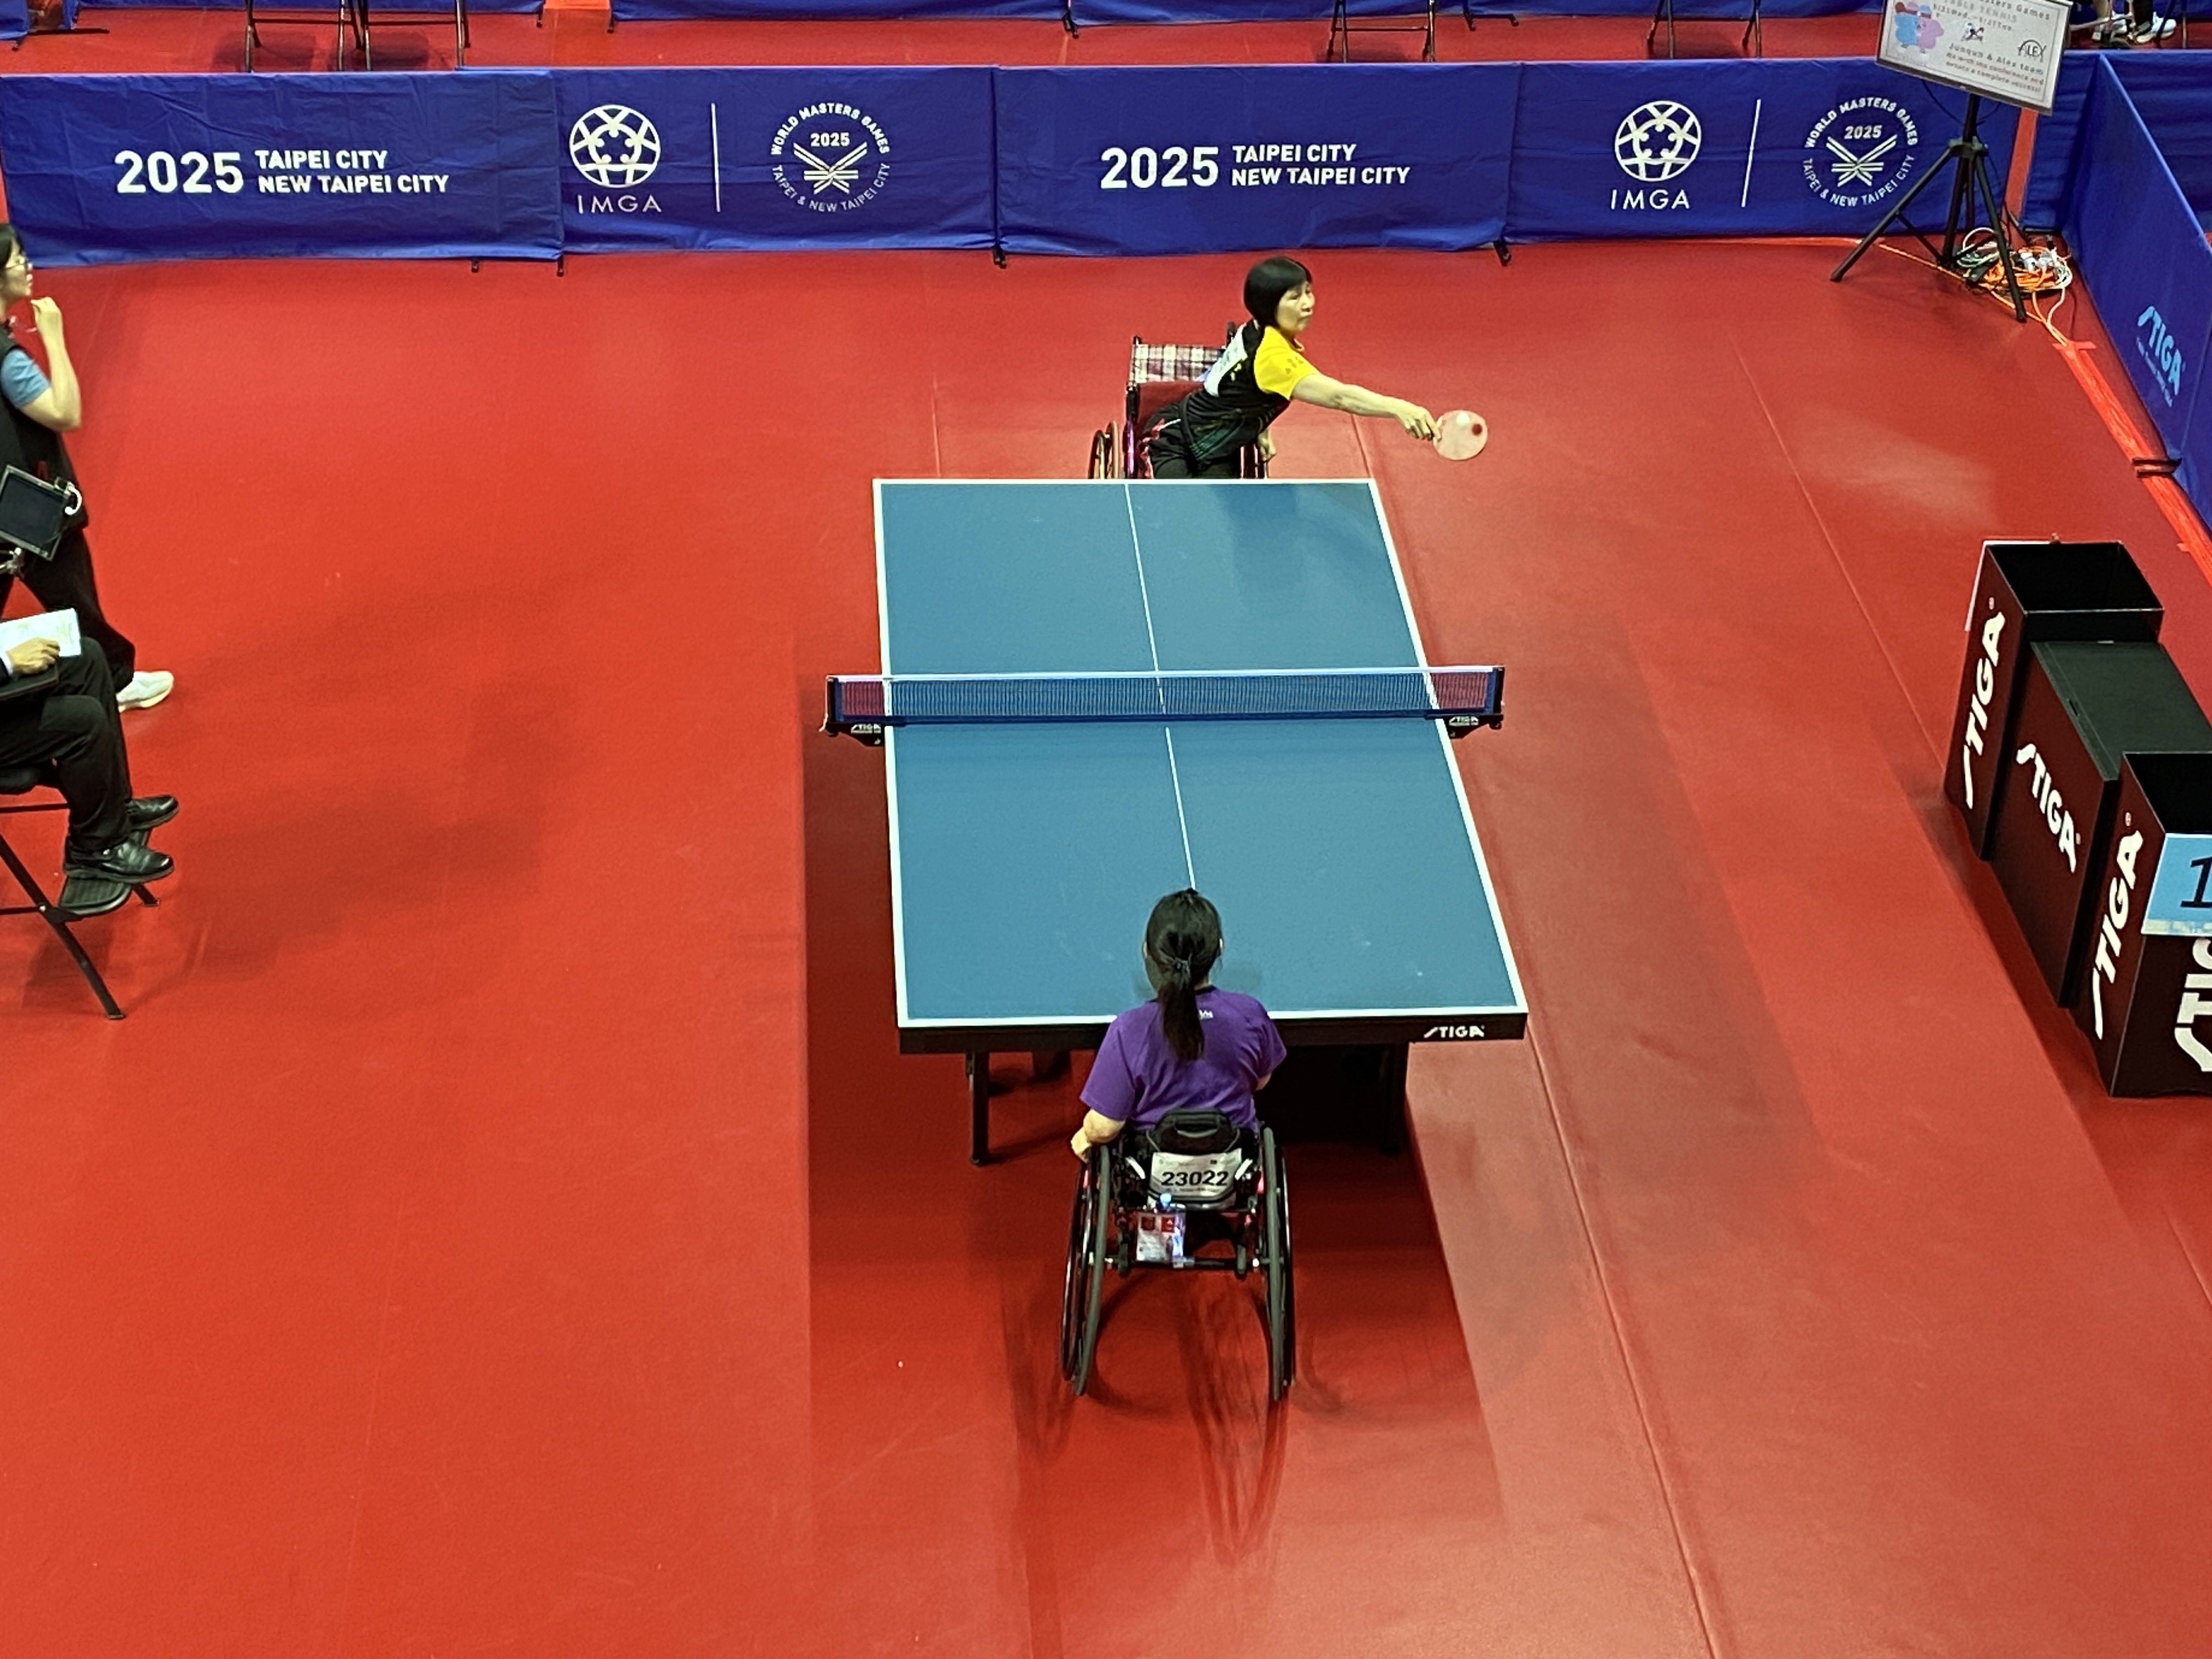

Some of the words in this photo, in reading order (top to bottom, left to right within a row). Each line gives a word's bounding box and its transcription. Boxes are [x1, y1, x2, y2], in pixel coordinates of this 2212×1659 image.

[2016, 4, 2050, 20] Games
[771, 116, 798, 155] WORLD
[798, 103, 860, 120] MASTERS
[861, 116, 890, 154] GAMES
[1804, 110, 1837, 148] WORLD
[1839, 97, 1897, 114] MASTERS
[1896, 109, 1918, 146] GAMES
[1844, 125, 1882, 139] 2025
[811, 132, 850, 147] 2025
[255, 150, 330, 169] TAIPEI
[336, 150, 388, 169] CITY
[1232, 144, 1301, 163] TAIPEI
[1307, 144, 1357, 162] CITY
[115, 150, 244, 193] 2025
[1101, 146, 1218, 189] 2025
[1232, 167, 1282, 186] NEW
[1287, 167, 1356, 185] TAIPEI
[1362, 167, 1410, 184] CITY
[258, 175, 312, 193] NEW
[317, 175, 392, 193] TAIPEI
[398, 174, 449, 193] CITY
[772, 165, 797, 198] TAIPEI
[798, 196, 805, 205] &
[809, 200, 837, 212] NEW
[840, 188, 877, 210] TAIPEI
[873, 163, 890, 188] CITY
[1803, 159, 1822, 192] TAIPEI
[1820, 189, 1829, 199] &
[1830, 194, 1858, 207] NEW
[1861, 179, 1898, 205] TAIPEI
[1896, 154, 1915, 180] CITY
[578, 195, 662, 214] IMGA
[1611, 189, 1689, 210] IMGA
[2137, 306, 2181, 396] STIGA
[1963, 612, 2005, 809] STIGA
[2016, 743, 2077, 873] STIGA
[2092, 830, 2143, 1040] STIGA
[1424, 1025, 1485, 1038] STIGA
[1161, 1170, 1229, 1186] 23022
